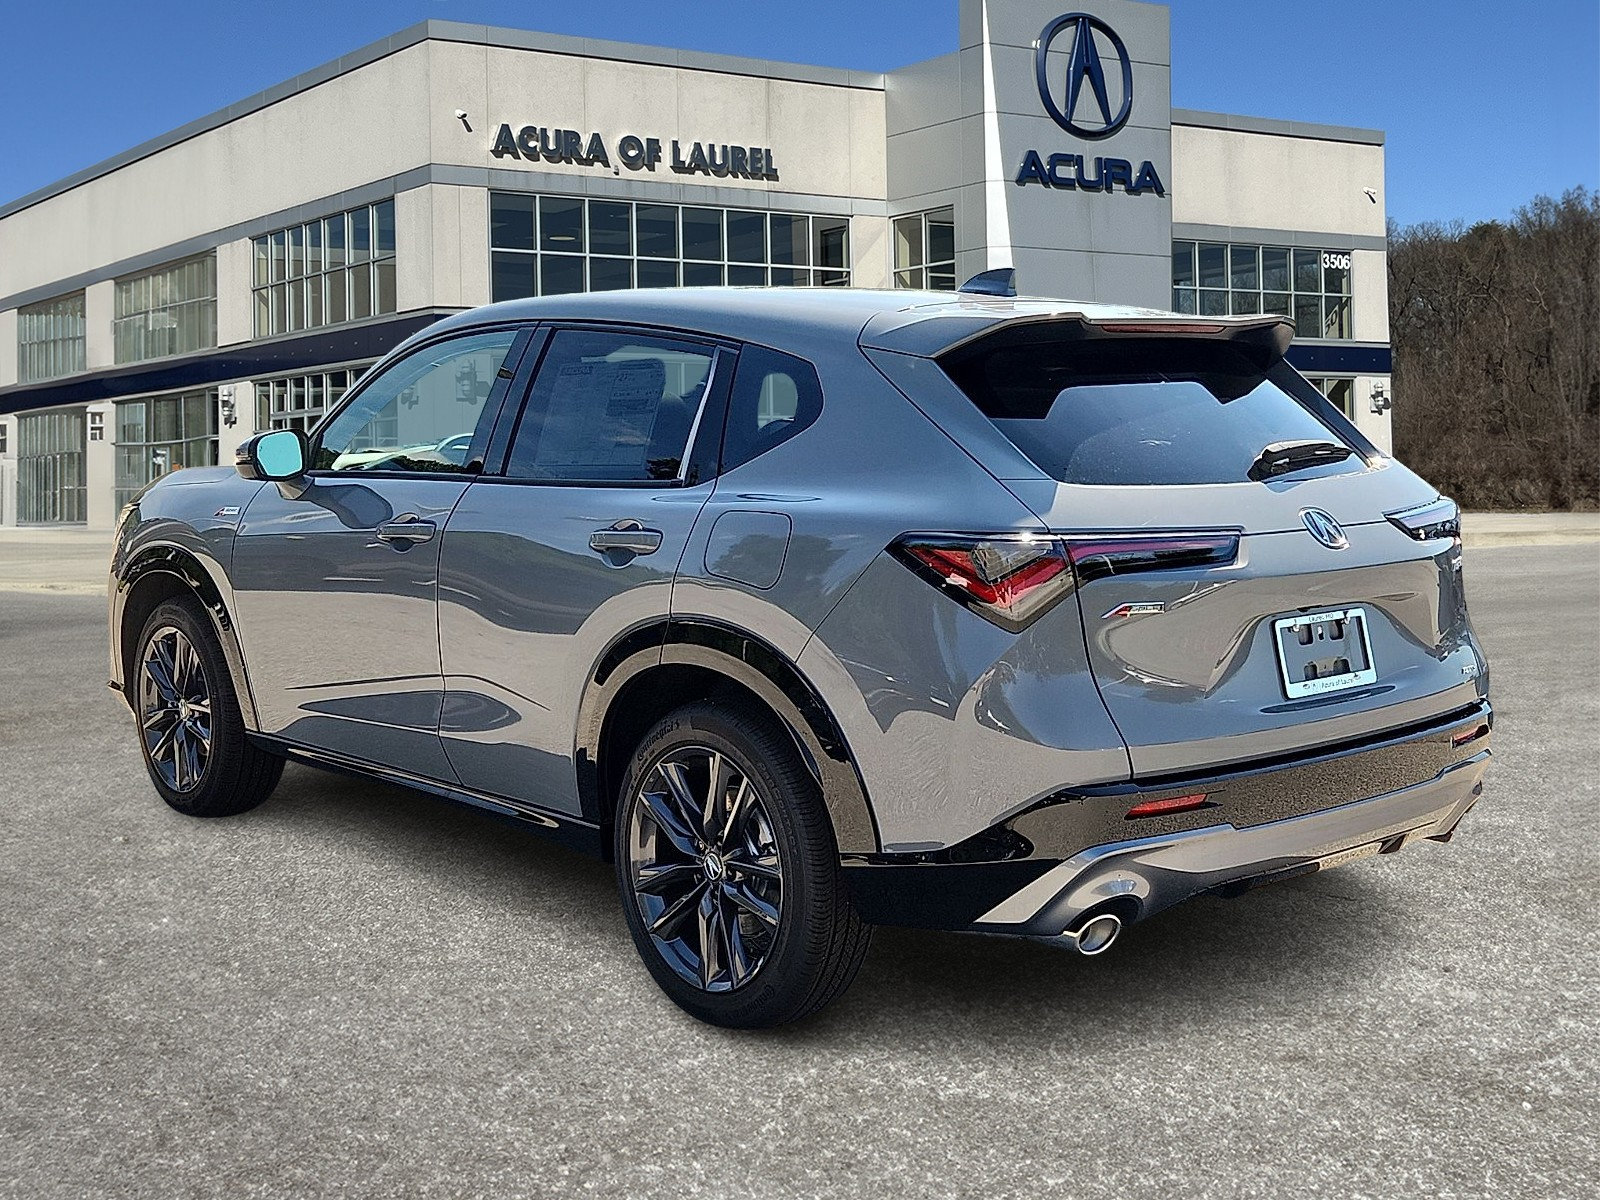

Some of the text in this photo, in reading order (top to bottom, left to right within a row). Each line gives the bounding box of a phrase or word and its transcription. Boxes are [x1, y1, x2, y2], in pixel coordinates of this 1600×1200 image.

[490, 123, 780, 182] ACURA OF LAUREL
[1015, 150, 1166, 198] ACURA
[1322, 253, 1351, 270] 3506
